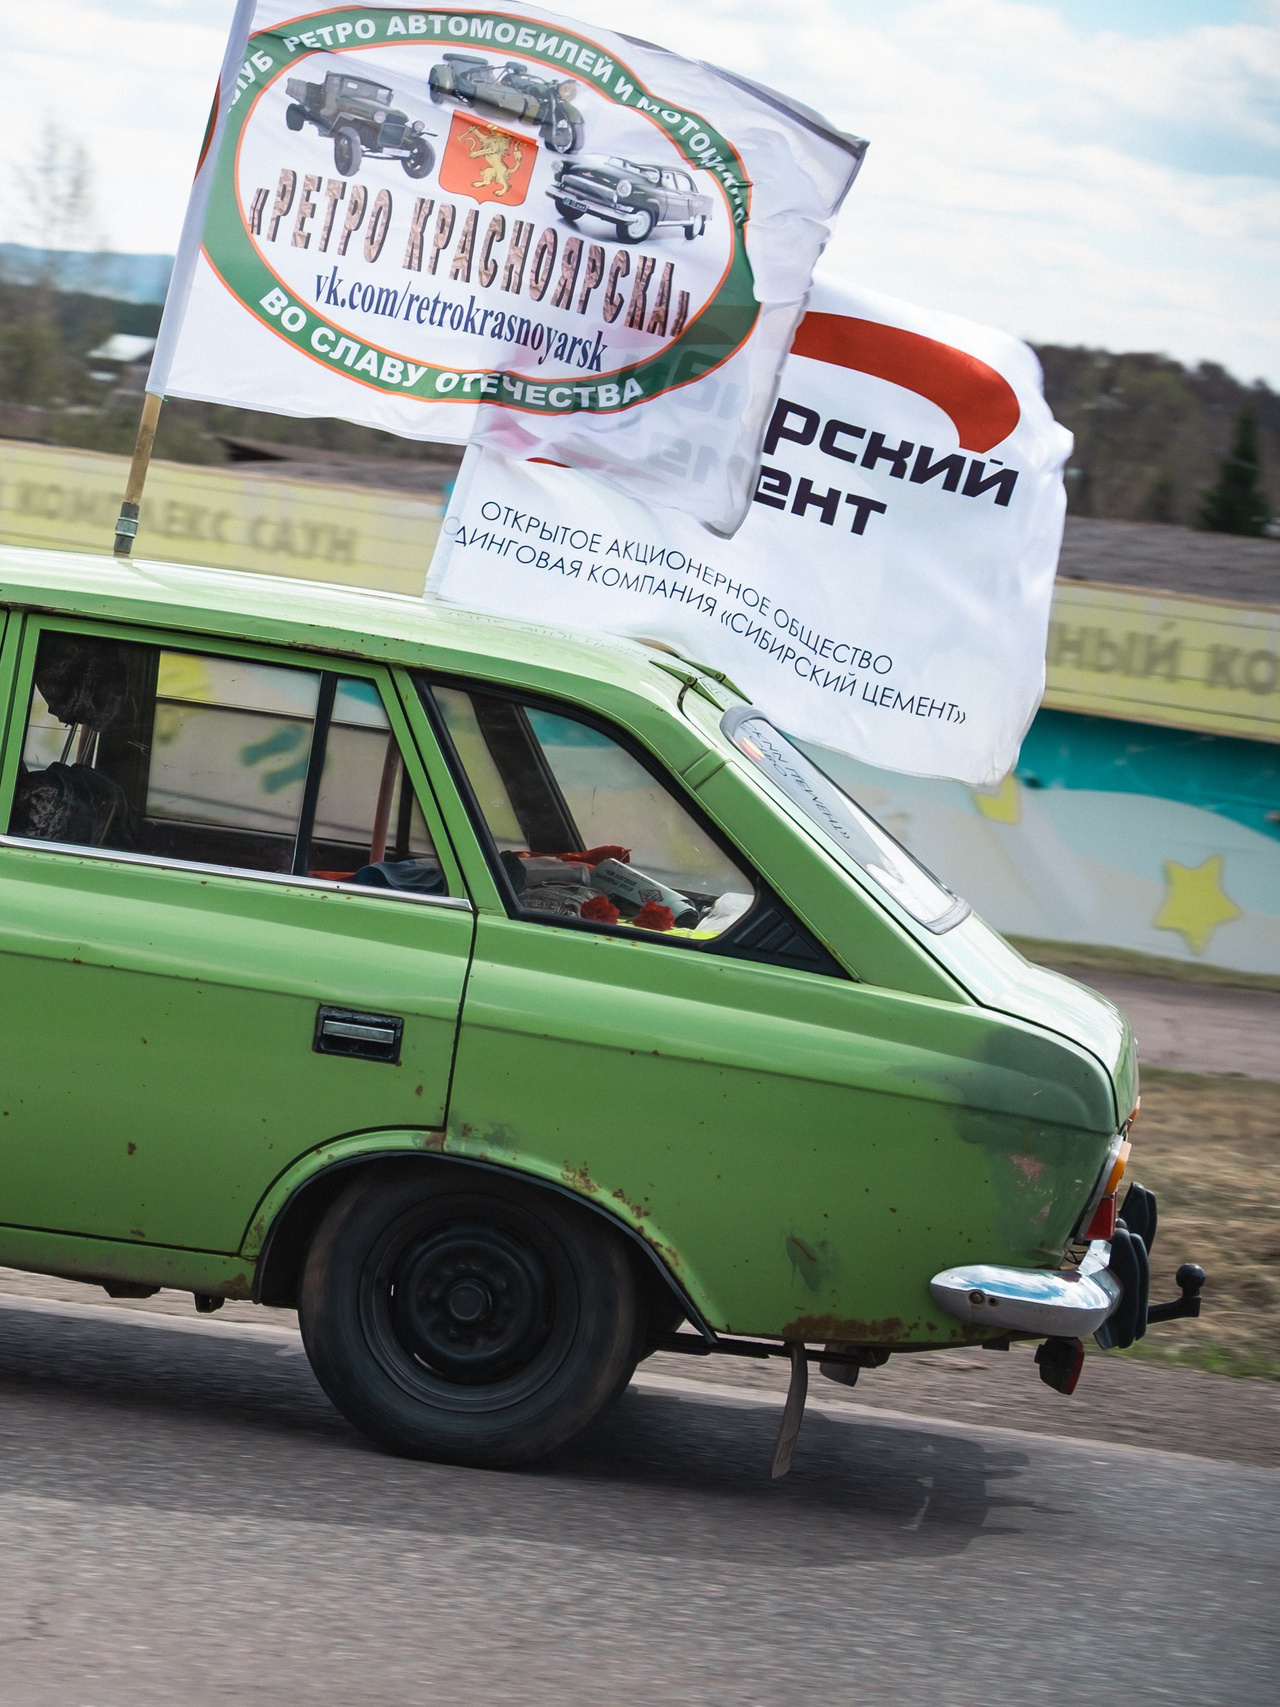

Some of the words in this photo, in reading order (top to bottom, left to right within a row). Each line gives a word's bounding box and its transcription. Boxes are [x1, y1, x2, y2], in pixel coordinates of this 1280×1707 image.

[228, 50, 274, 113] ЛУБ
[283, 19, 376, 52] РЕТРО
[386, 15, 616, 84] АВТОМОБИЛЕЙ
[613, 76, 634, 102] И
[248, 168, 393, 263] «РЕТРО
[402, 197, 691, 337] КРАСНОЯРСКА»
[258, 286, 307, 333] ВО
[310, 326, 429, 387] СЛАВУ
[434, 372, 645, 409] ОТЕЧЕСТВА
[315, 265, 609, 373] vk.com/retrokrasnoyarsk
[752, 463, 888, 536] ент
[761, 397, 1020, 508] рский
[454, 525, 583, 578] ДИНГОВАЯ
[587, 563, 718, 617] КОМПАНИЯ
[720, 609, 858, 697] «СИБИРСКИЙ
[861, 681, 967, 725] ЦЕМЕНТ»
[481, 501, 603, 553] ОТКРЫТОЕ
[605, 538, 771, 617] АКЦИОНЕРНОЕ
[773, 608, 893, 675] ОБЩЕСТВО
[1048, 620, 1184, 683] НЫЙ
[1206, 642, 1280, 696] КО
